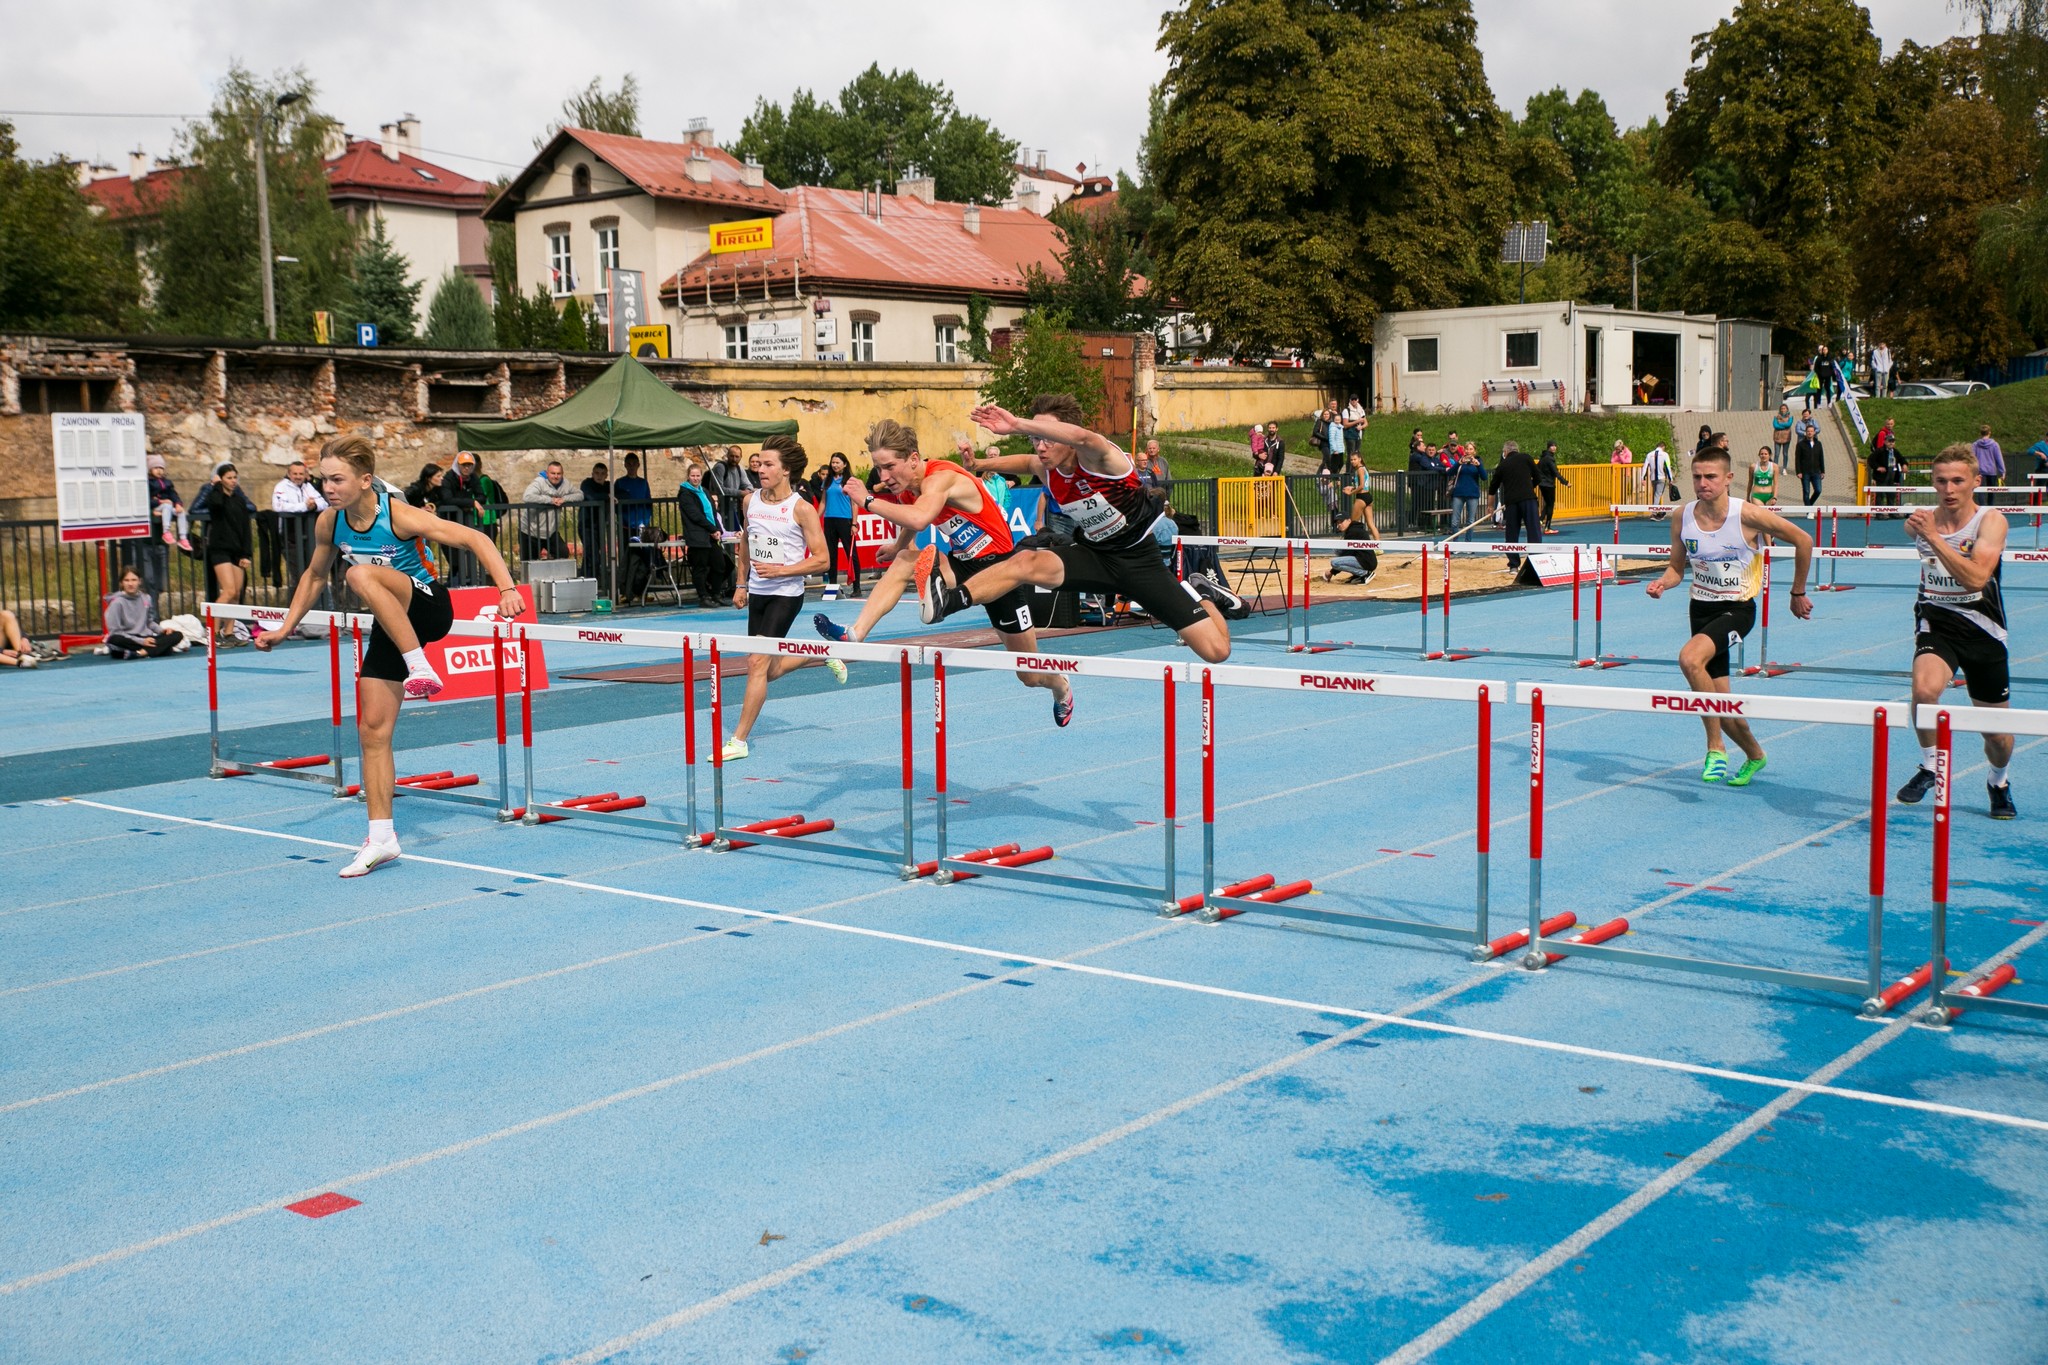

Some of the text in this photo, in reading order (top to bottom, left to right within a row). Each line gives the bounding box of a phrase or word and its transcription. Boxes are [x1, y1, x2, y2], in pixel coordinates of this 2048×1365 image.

[716, 226, 763, 246] PIRELLI
[361, 326, 374, 346] P
[752, 337, 799, 345] PROFESJONALNY
[61, 417, 101, 426] ZAWODNIK
[91, 468, 115, 477] WYNIK
[1083, 498, 1097, 511] 29
[950, 516, 963, 529] 46
[767, 537, 779, 546] 38
[975, 540, 988, 551] 2022
[1347, 541, 1380, 549] POLANIK
[755, 548, 773, 559] DYJA
[1491, 544, 1527, 552] POLANIK
[1821, 549, 1865, 558] POLANIK
[371, 557, 383, 565] 42
[2014, 553, 2048, 561] POLAN
[1723, 562, 1731, 572] 9
[1695, 572, 1739, 587] KOWALSKI
[251, 609, 285, 621] POLANIK
[1021, 609, 1028, 625] 5
[578, 630, 623, 643] POLANIK
[778, 641, 830, 656] POLANIK
[1016, 656, 1079, 672] POLANIK
[1300, 674, 1375, 691] POLANIK
[1651, 695, 1744, 715] POLANIK
[1531, 724, 1539, 769] POLANIK
[1935, 751, 1946, 802] POLANIK
